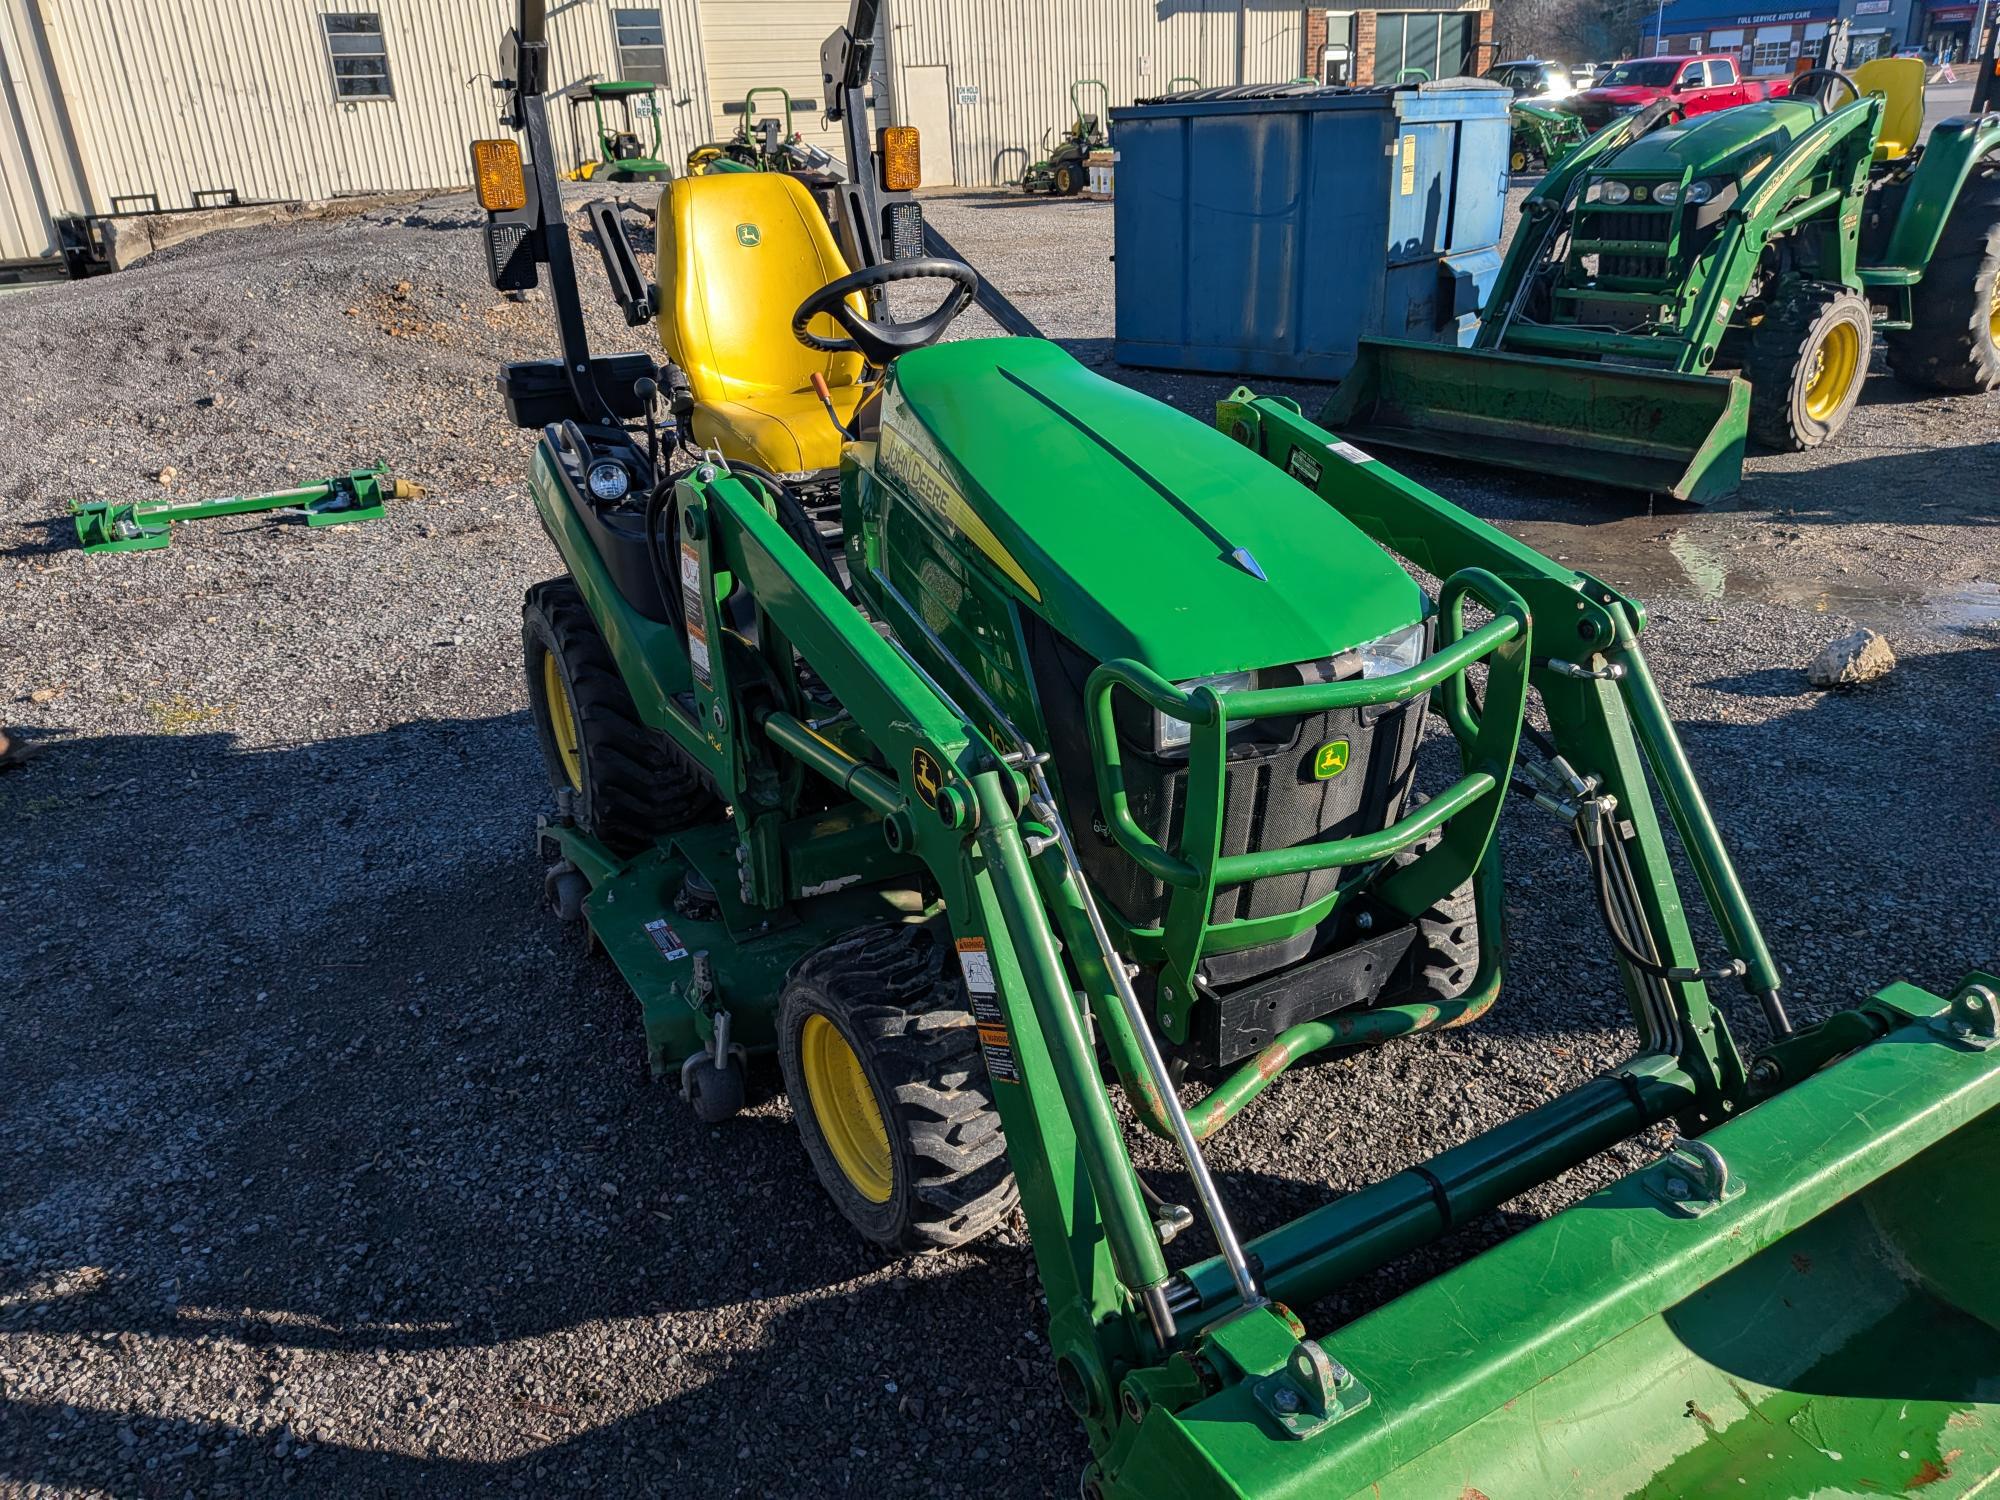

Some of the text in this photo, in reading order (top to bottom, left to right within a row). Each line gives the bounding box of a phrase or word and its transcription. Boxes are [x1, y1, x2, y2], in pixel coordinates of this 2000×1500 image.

[1737, 11, 1811, 25] FULL SERVICE AUTO CARE
[884, 439, 951, 516] JOHN DEERE
